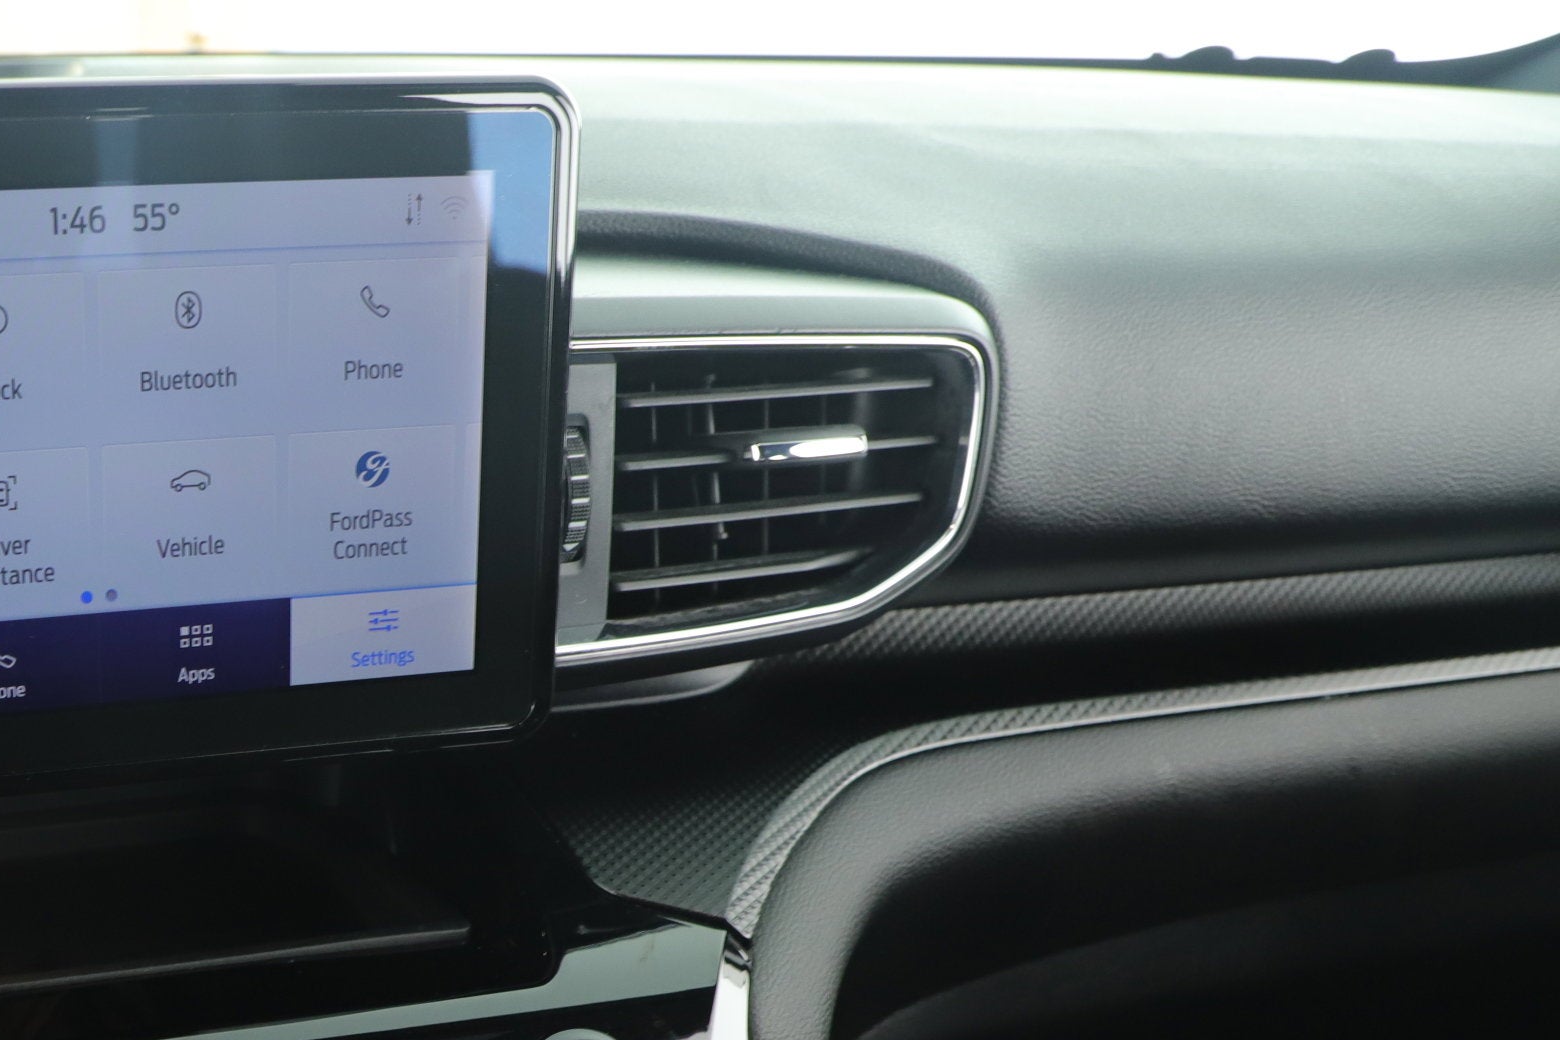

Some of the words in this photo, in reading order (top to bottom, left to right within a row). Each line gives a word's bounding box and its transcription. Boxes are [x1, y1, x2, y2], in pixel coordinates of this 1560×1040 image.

[49, 205, 106, 235] 1:46
[132, 203, 180, 232] 55°
[140, 366, 237, 392] Bluetooth
[344, 360, 404, 380] Phone
[329, 509, 413, 532] FordPass
[157, 535, 225, 559] Vehicle
[333, 537, 408, 560] Connect
[350, 648, 415, 669] Settings
[177, 665, 215, 685] Apps
